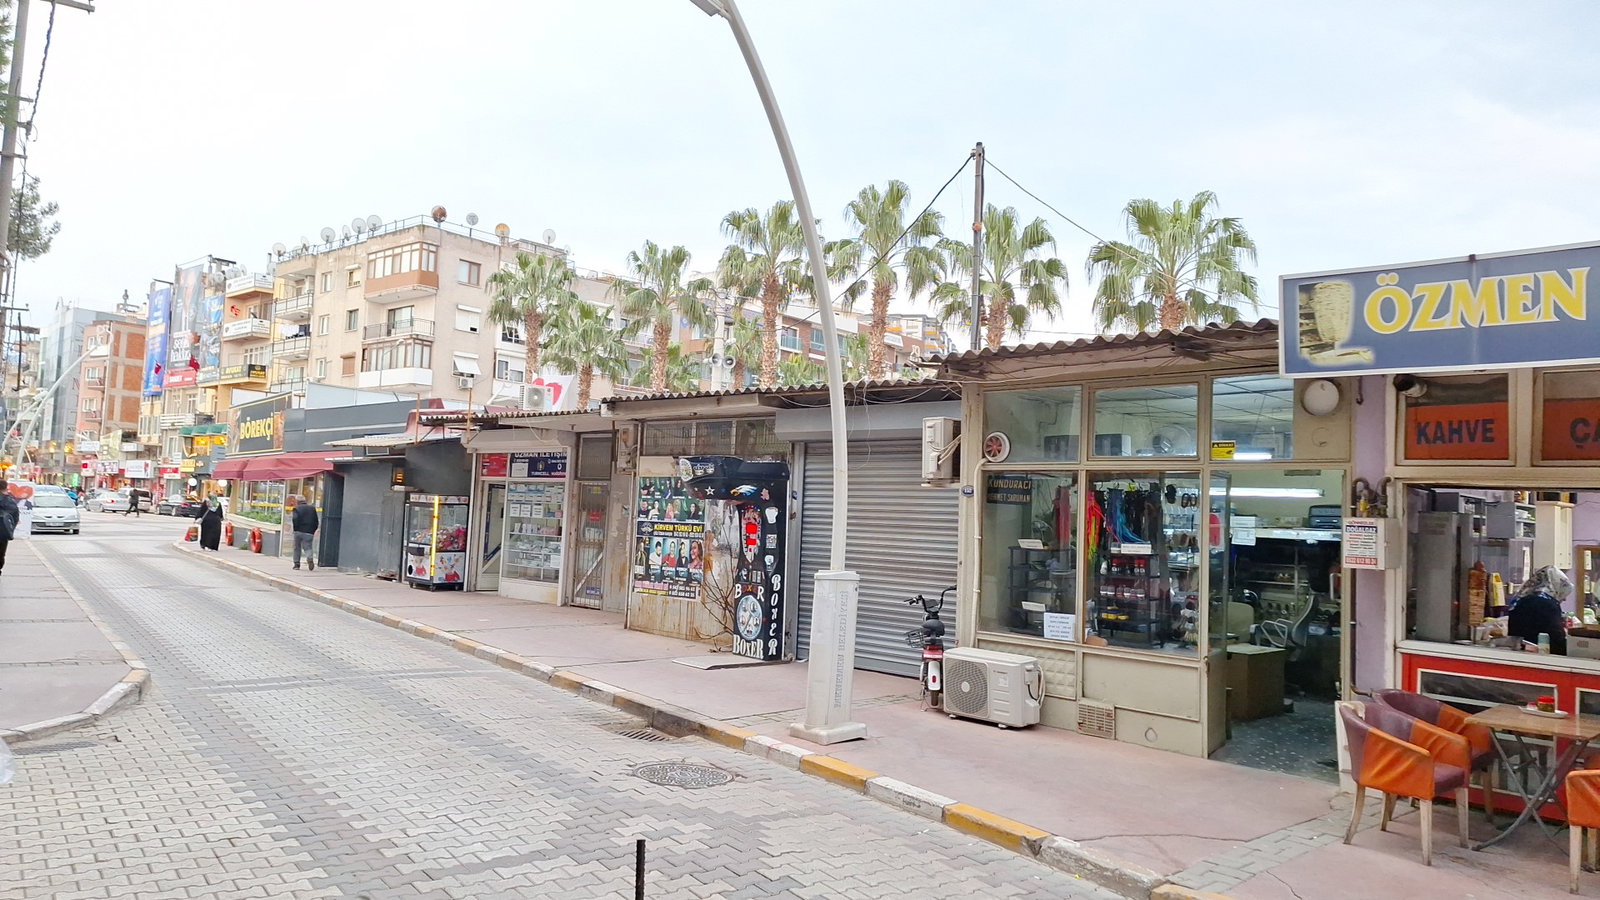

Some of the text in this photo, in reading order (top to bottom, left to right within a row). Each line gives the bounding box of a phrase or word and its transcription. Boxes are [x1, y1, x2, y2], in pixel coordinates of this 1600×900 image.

[1363, 267, 1591, 334] ÖZMEN
[240, 412, 274, 440] BÖREKÇİ
[1416, 418, 1495, 445] KAHVE
[989, 479, 1032, 490] KUNDURACI
[674, 524, 692, 533] TÜRKÜ
[693, 525, 703, 533] EVİ
[1346, 525, 1377, 534] DOĞALGAZ
[732, 634, 764, 660] BOXER
